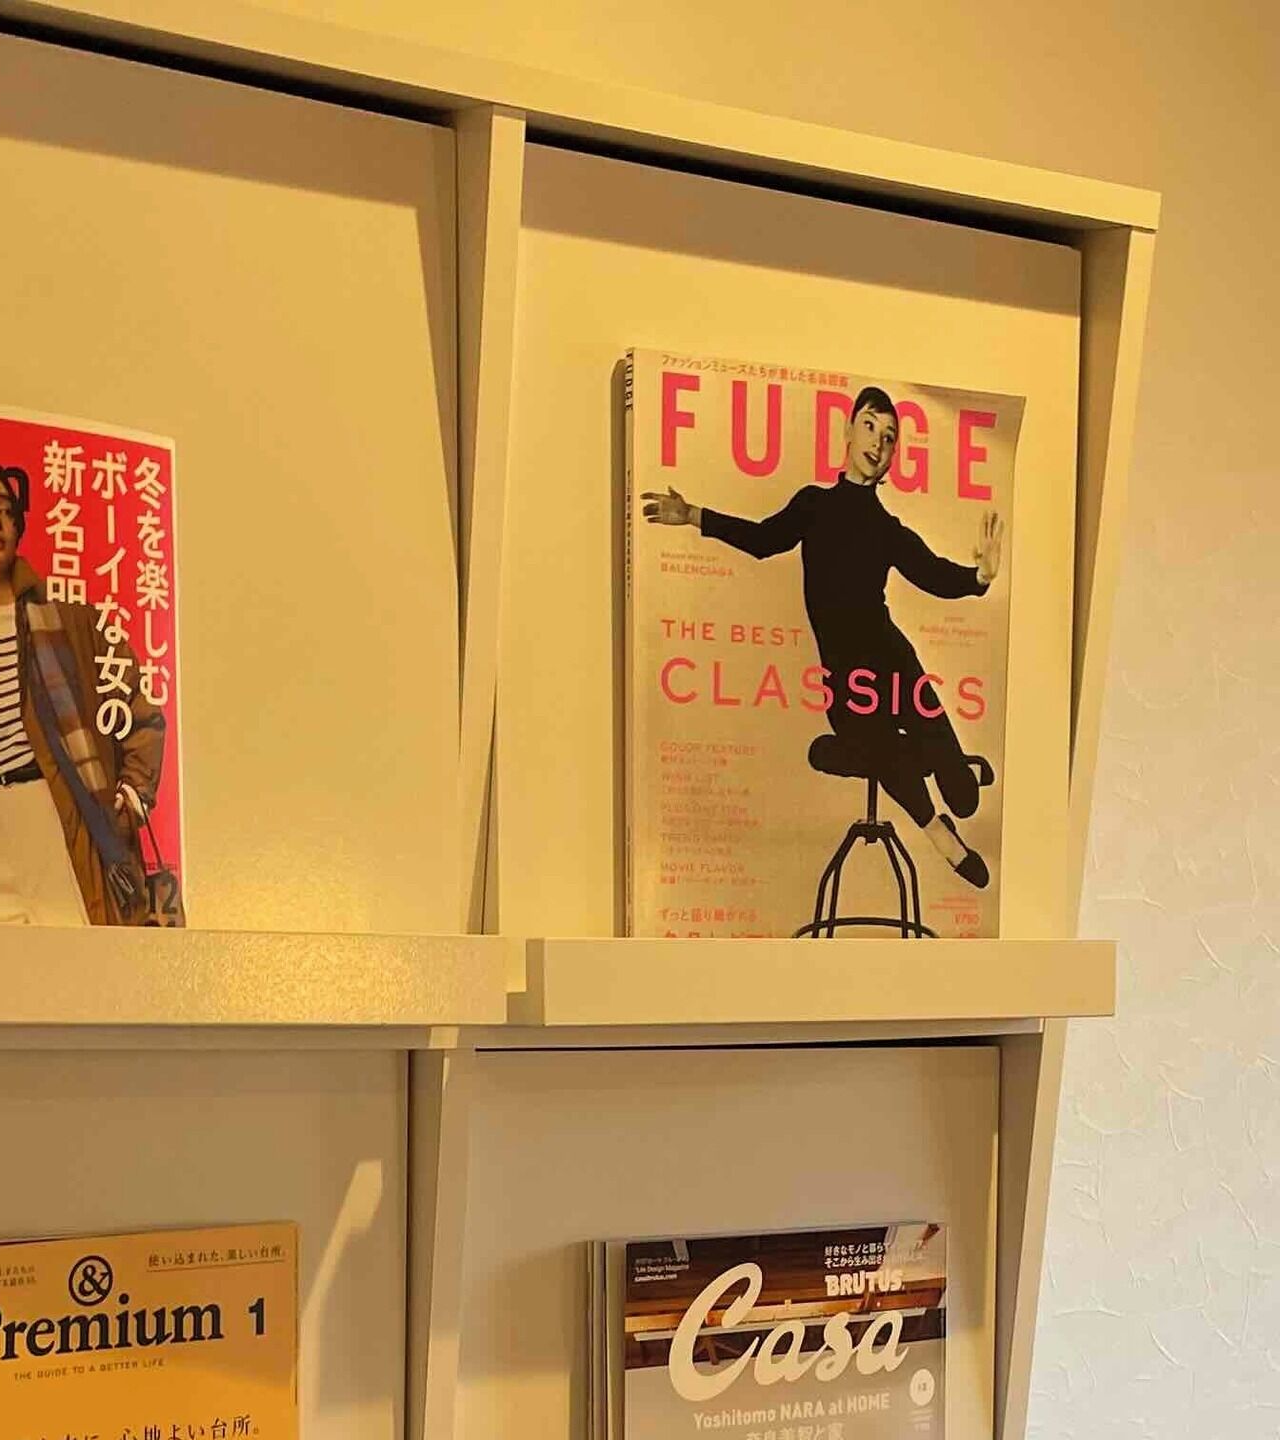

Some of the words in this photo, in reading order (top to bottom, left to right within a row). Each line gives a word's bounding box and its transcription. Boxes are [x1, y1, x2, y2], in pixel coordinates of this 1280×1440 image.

[661, 371, 997, 501] FUDGE
[43, 441, 87, 605] 新名品
[92, 451, 133, 741] ボーイな女の
[134, 456, 171, 707] 冬を楽しむ
[661, 619, 715, 641] THE
[731, 624, 803, 647] BEST
[660, 657, 988, 721] CLASSICS
[74, 1260, 112, 1301] &
[824, 1269, 904, 1297] BRUTUS
[248, 1297, 265, 1336] 1
[669, 1262, 910, 1401] Casa
[694, 1408, 776, 1430] Yoshitomo
[780, 1401, 824, 1421] NARA
[828, 1400, 843, 1415] at
[847, 1393, 891, 1413] HOME
